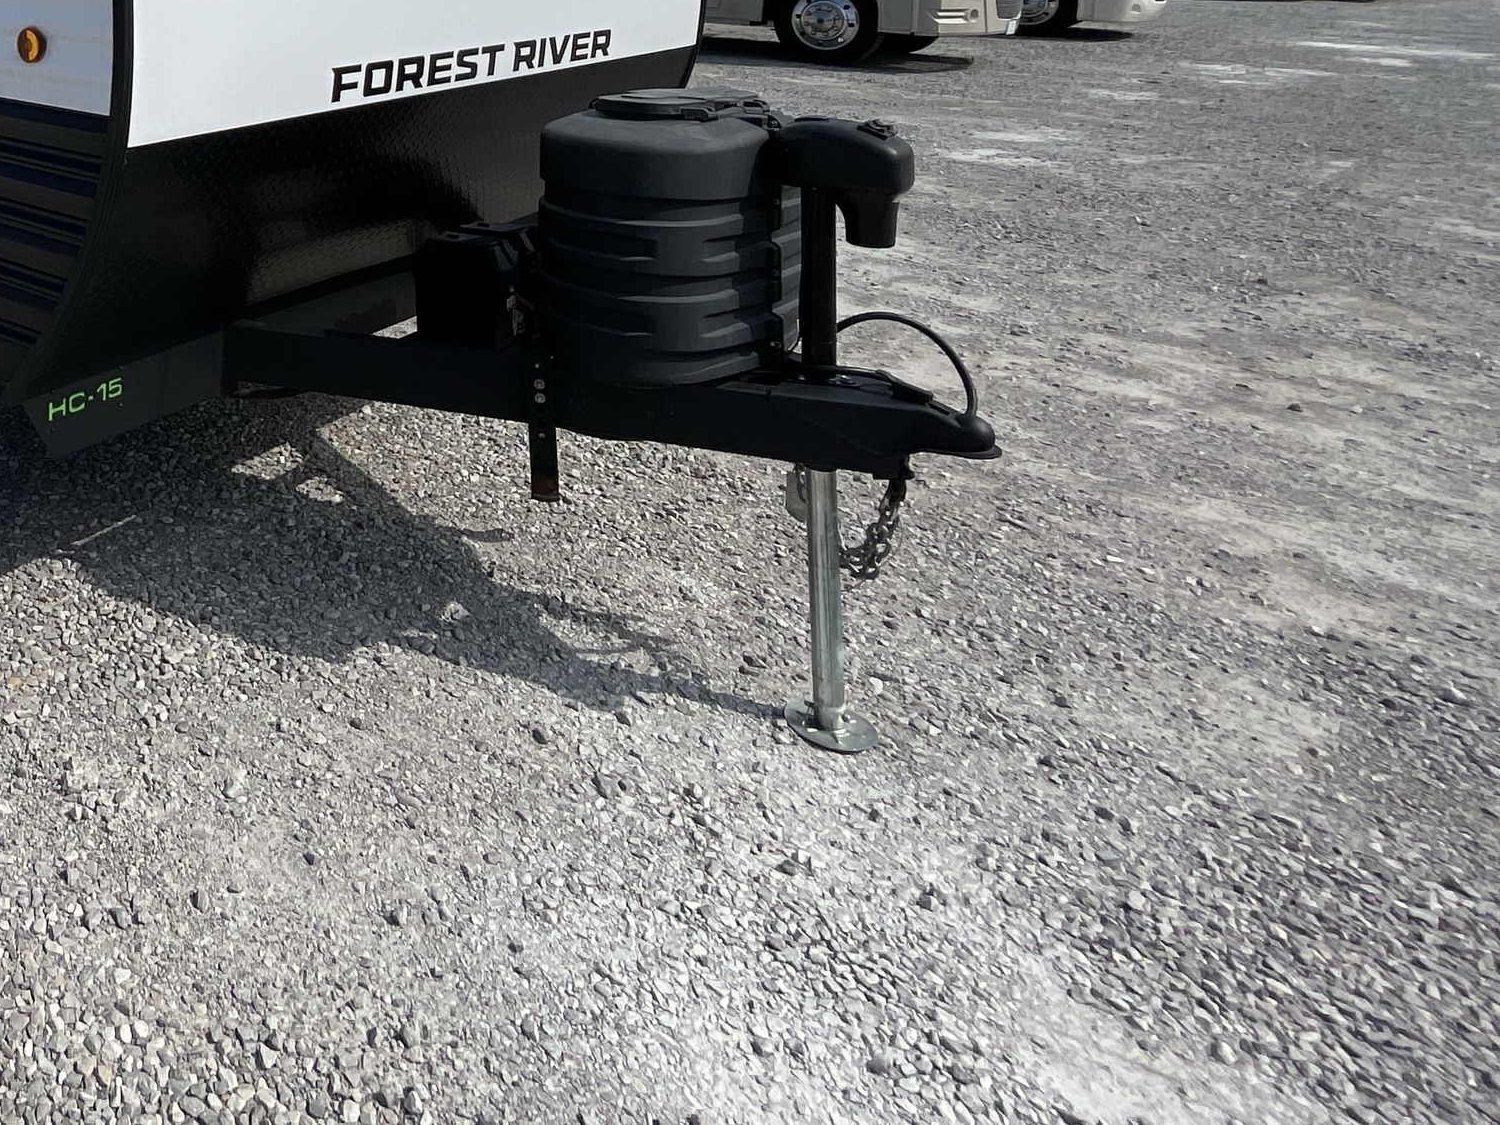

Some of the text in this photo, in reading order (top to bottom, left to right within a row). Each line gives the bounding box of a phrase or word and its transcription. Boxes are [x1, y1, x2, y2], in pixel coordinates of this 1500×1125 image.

[331, 28, 612, 103] FOREST RIVER
[48, 377, 122, 422] HC-15
